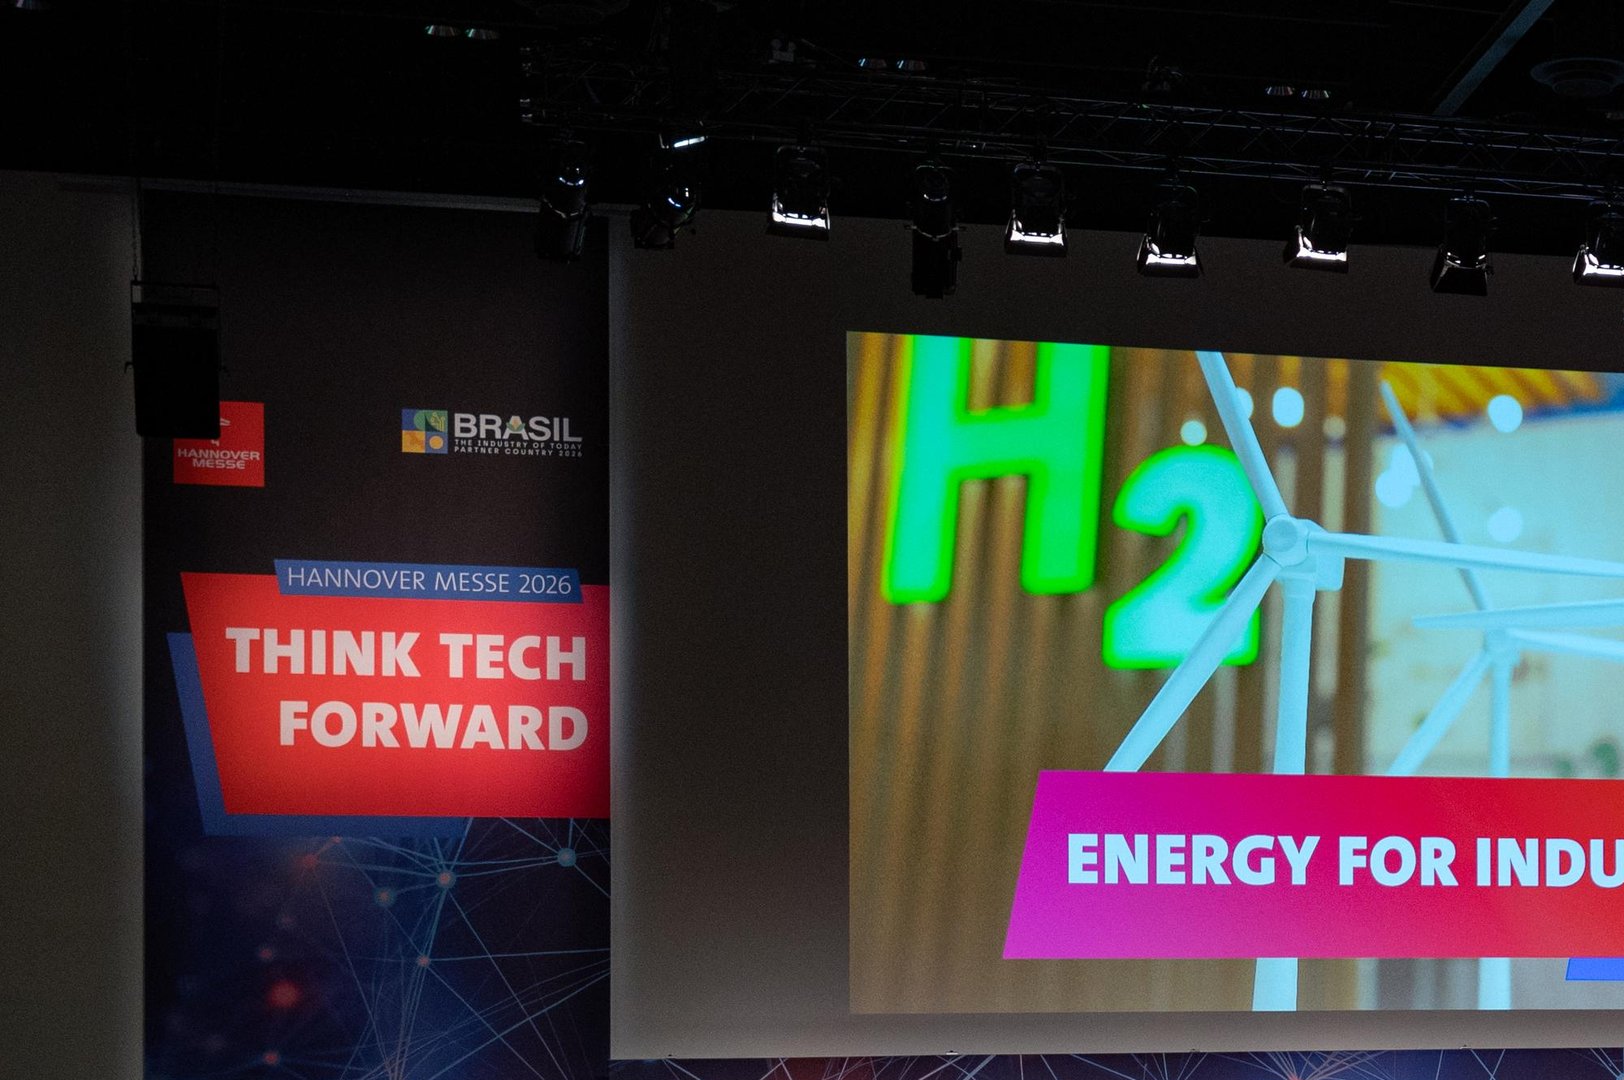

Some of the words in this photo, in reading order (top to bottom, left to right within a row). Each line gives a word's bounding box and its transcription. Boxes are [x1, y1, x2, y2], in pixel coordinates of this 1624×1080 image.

[454, 412, 583, 443] BRASIL
[177, 448, 260, 460] HANNOVER
[454, 446, 500, 454] PARTNER
[504, 448, 553, 456] COUNTRY
[558, 450, 583, 458] 2026
[455, 439, 473, 447] THE
[477, 440, 528, 449] INDUSTRY
[192, 458, 246, 470] MESSE
[287, 566, 426, 592] HANNOVER
[434, 571, 510, 594] MESSE
[518, 573, 572, 595] 2026
[225, 626, 421, 677] THINK
[439, 634, 587, 682] TECH
[279, 700, 589, 751] FORWARD
[1067, 832, 1320, 888] ENERGY
[1340, 835, 1457, 888] FOR
